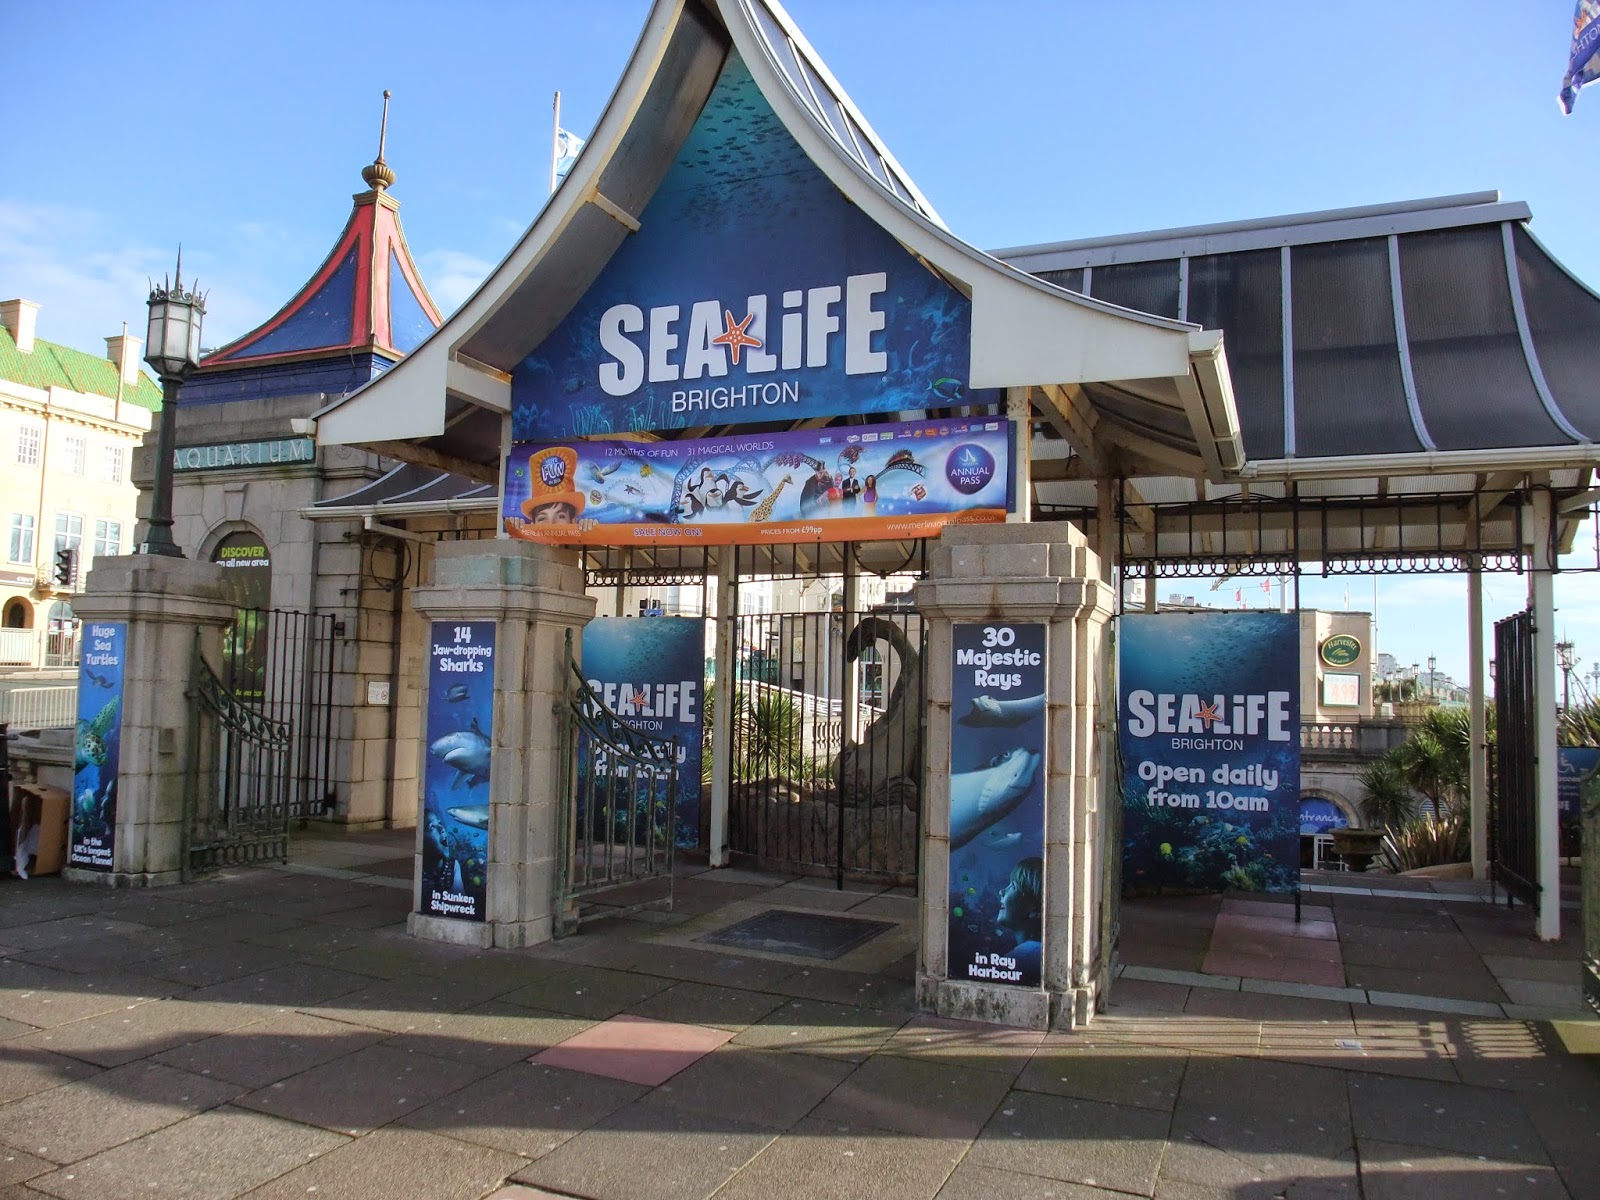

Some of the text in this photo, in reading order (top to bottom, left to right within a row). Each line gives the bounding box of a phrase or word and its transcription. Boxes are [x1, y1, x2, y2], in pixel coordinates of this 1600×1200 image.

[599, 300, 728, 396] SEA
[672, 381, 799, 412] BRIGHTON
[174, 439, 305, 469] AQUARIUM
[604, 441, 774, 458] 12 MONTHS OF FUN 31 MAGICAL WORLDS
[541, 461, 565, 481] FUN
[950, 467, 990, 477] ANNUAL
[960, 476, 981, 485] PASS
[633, 528, 656, 537] SALE
[658, 528, 682, 537] NOW
[782, 527, 800, 535] FROM
[801, 526, 823, 535] £99pp
[221, 546, 265, 558] DISCOVER
[225, 558, 236, 567] all
[251, 559, 269, 567] area
[92, 625, 116, 639] Huge
[453, 626, 472, 643] 14
[982, 627, 1015, 647] 30
[94, 639, 112, 651] Sea
[432, 644, 492, 659] Jaw-dropping
[1327, 639, 1357, 651] Harvester
[86, 653, 119, 666] Turtles
[440, 657, 484, 672] Sharks
[956, 648, 1041, 670] Majestic
[974, 670, 1022, 690] Rays
[1127, 689, 1204, 737] SEA
[1171, 738, 1244, 750] BRIGHTON
[594, 760, 629, 778] frm
[1138, 761, 1279, 791] Open daily
[1147, 787, 1269, 812] from 10am
[1300, 810, 1341, 822] ntrance
[83, 837, 102, 846] in the
[87, 846, 112, 857] longest
[71, 853, 113, 866] Ocean Tunnel
[432, 890, 475, 904] in Sunken
[431, 900, 475, 915] Shipwreck
[975, 952, 1016, 970] in Ray
[968, 964, 1023, 980] Harbour
